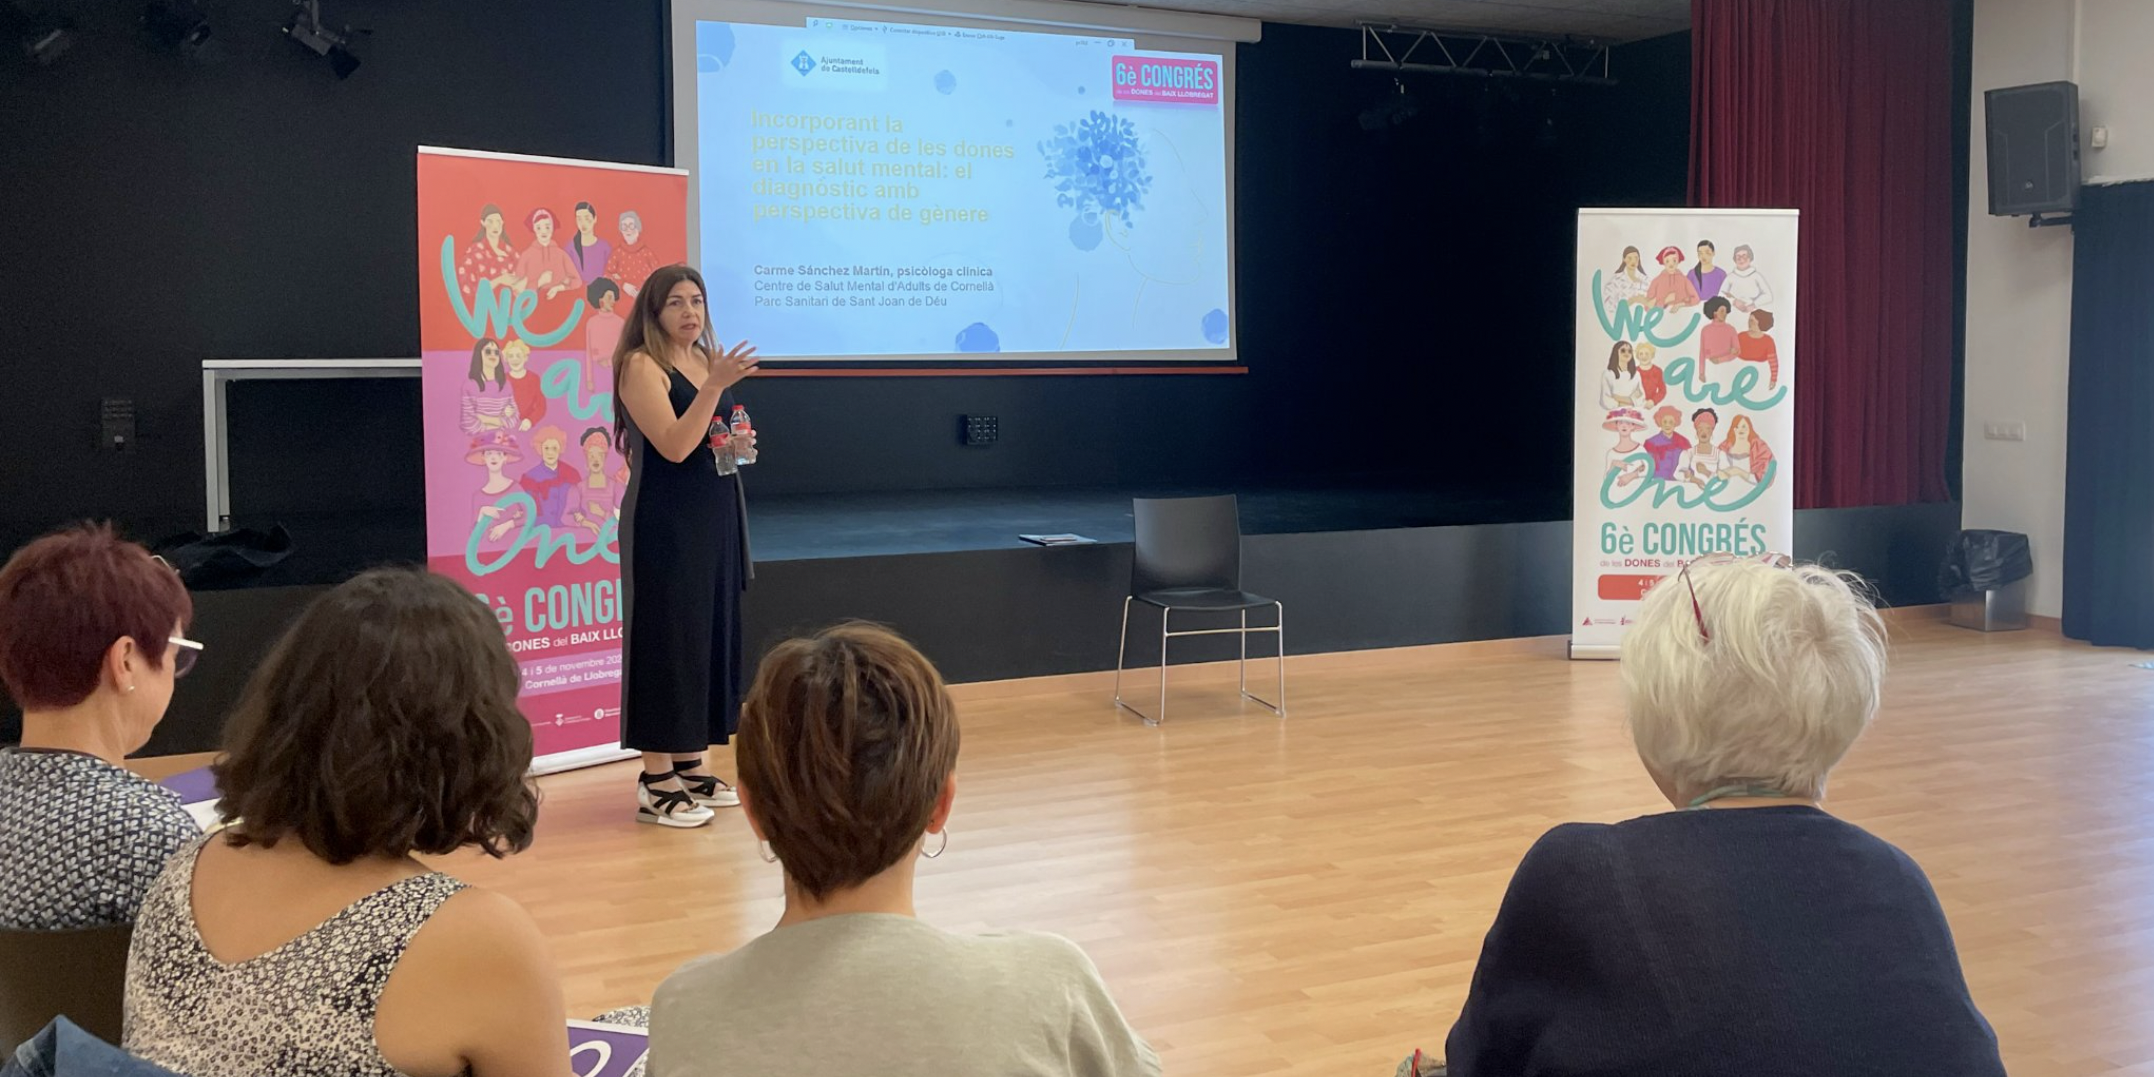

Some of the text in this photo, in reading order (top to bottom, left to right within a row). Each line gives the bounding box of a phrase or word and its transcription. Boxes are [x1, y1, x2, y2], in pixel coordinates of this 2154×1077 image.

[821, 56, 864, 65] Ajuntament
[831, 65, 880, 75] Castelldefels
[1115, 62, 1214, 90] 6è CONGRÉS
[751, 110, 903, 133] Incorporant la
[752, 135, 1015, 158] perspectiva de les dones
[752, 155, 972, 179] en la salut mental: el
[752, 177, 919, 200] diagnòstic amb
[753, 202, 988, 225] perspectiva de gènere
[754, 265, 795, 275] Carme
[798, 265, 850, 276] Sánchez
[897, 266, 953, 279] psicòloga
[441, 235, 585, 347] We
[754, 280, 994, 291] Centre de Salut Mental d'Adults de Cornellà
[754, 296, 947, 307] Parc Sanitari de Sant Joan de Déu
[1592, 269, 1701, 348] We
[541, 358, 615, 422] ar
[1663, 356, 1788, 411] are
[1600, 452, 1777, 512] One
[1600, 517, 1767, 556] 6è CONGRÉS
[1624, 559, 1661, 568] DONES
[525, 578, 623, 632] CONG
[553, 637, 568, 648] del
[571, 630, 600, 644] BAIX
[521, 668, 528, 676] 4
[536, 665, 542, 675] 5
[544, 664, 557, 674] de
[559, 659, 604, 671] novembre
[525, 669, 622, 689] Cornellà de Llobreg
